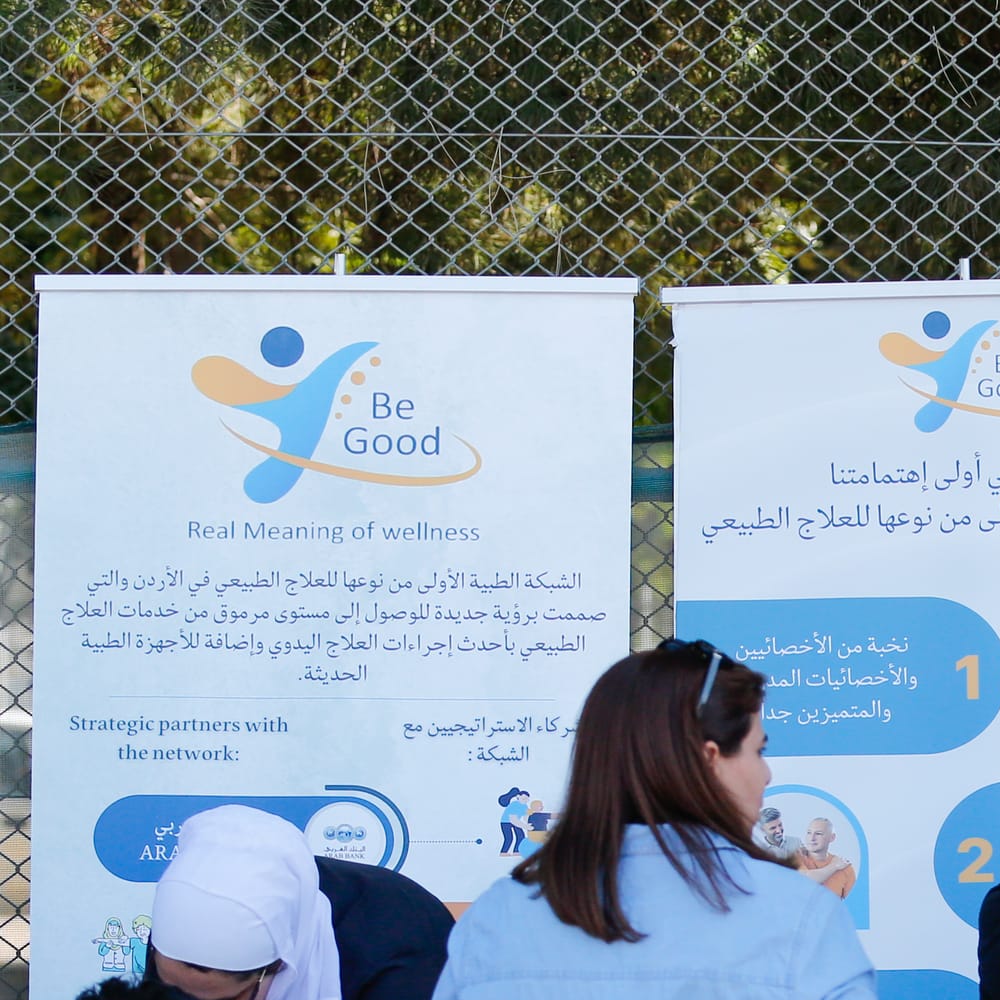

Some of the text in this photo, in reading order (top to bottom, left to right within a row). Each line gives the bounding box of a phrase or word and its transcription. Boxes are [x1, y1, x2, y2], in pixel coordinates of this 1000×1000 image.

[371, 391, 415, 420] Be
[343, 425, 441, 456] Good
[830, 459, 929, 492] إهتمامتنا
[934, 450, 981, 491] أولى
[187, 520, 480, 543] Real Meaning of wellness
[701, 505, 790, 544] الطبيعي
[796, 503, 870, 540] للعلاج
[876, 503, 933, 534] نوعها
[939, 512, 972, 534] من
[86, 565, 582, 597] الشبكة الطبية الأولى من نوعها للعلاج الطبيعي في الأردن والتي
[60, 600, 607, 625] صممت برؤية جديدة للوصول إلى مستوى مرموق من خدمات العلاج
[80, 628, 585, 661] الطبيعي بأحدث إجراءات العلاج اليدوي وإضافة للأجهزة الطبية
[734, 630, 910, 661] نخبة من الأخصائيين
[762, 662, 919, 691] والأخصائيات المد
[954, 654, 980, 700] 1
[69, 714, 288, 736] Strategic partners with
[427, 716, 531, 737] الاستراتيجيين
[796, 699, 892, 725] والمتميزين
[402, 722, 423, 739] مع
[118, 743, 240, 761] the network:
[138, 844, 179, 861] ARA
[957, 836, 994, 883] 2
